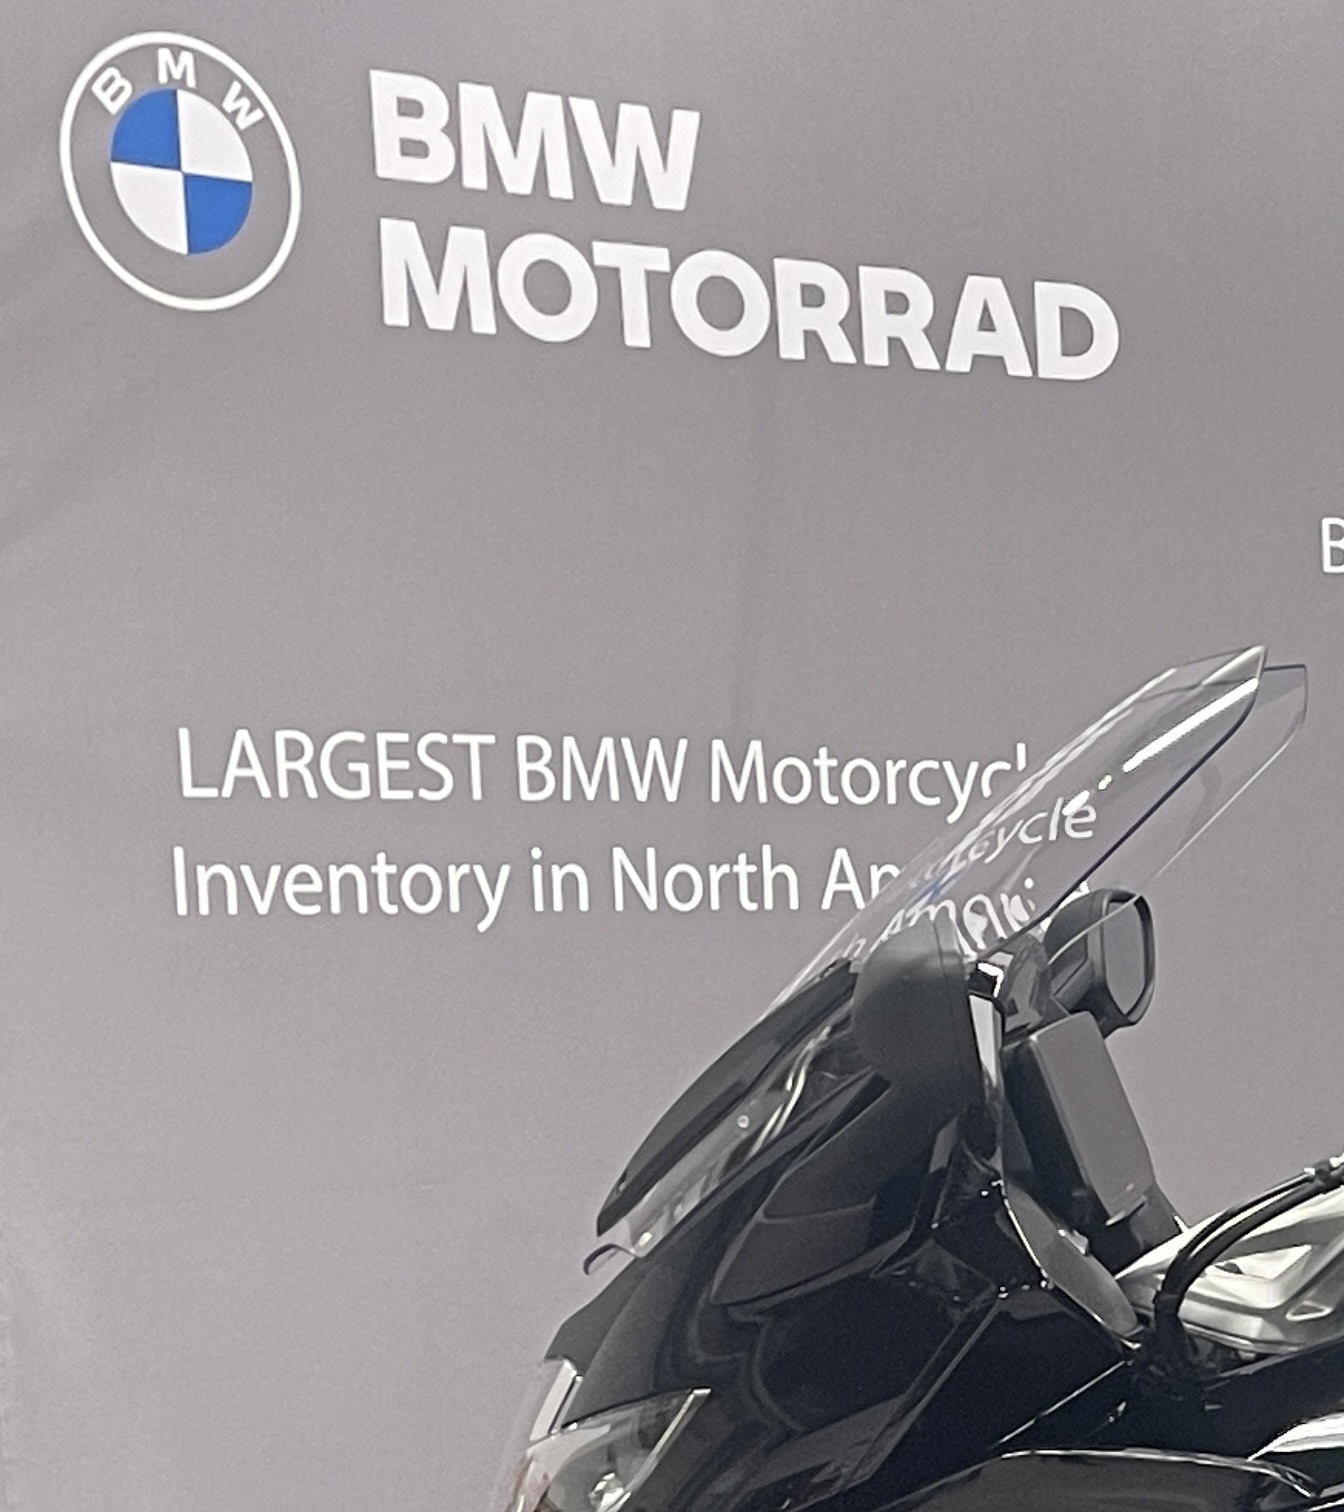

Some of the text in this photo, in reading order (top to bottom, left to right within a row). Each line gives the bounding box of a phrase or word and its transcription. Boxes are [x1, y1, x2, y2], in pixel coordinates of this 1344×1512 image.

[91, 46, 266, 131] BMW
[368, 68, 701, 212] BMW
[379, 216, 1120, 381] MOTORRAD
[177, 726, 497, 802] LARGEST
[516, 733, 689, 803] BMW
[172, 844, 512, 934] Inventory
[530, 846, 591, 913] in
[611, 843, 801, 914] North
